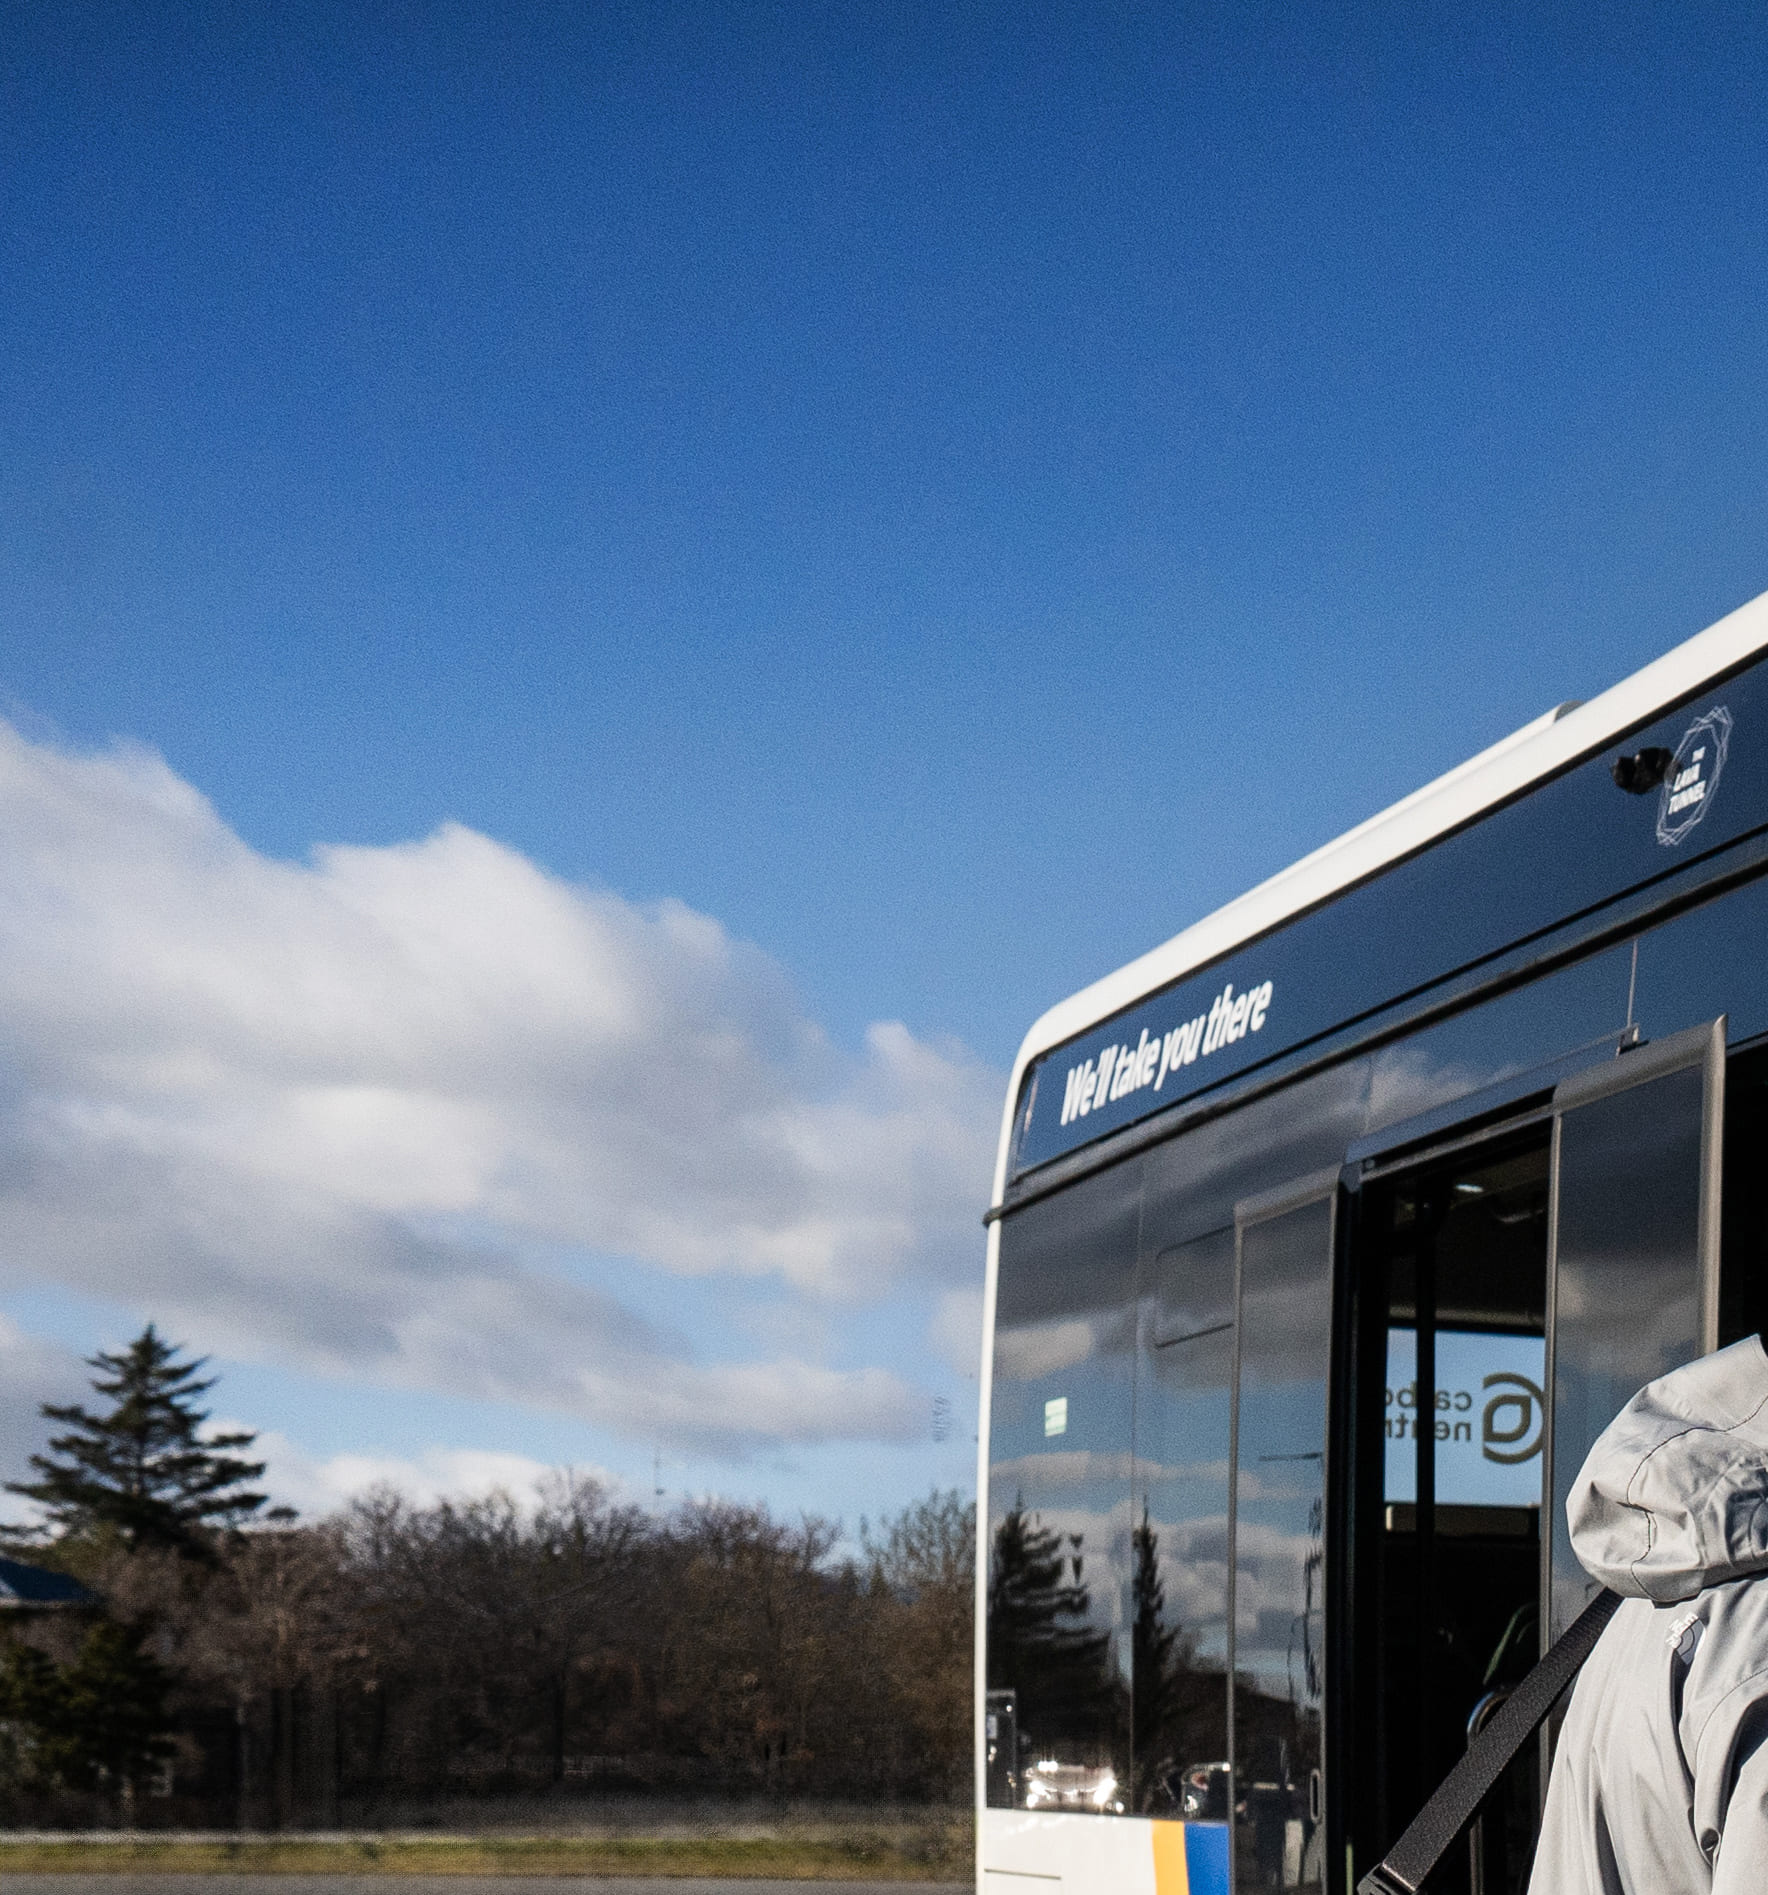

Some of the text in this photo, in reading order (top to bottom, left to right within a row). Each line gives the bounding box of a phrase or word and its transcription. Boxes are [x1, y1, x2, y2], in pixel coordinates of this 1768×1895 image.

[1061, 980, 1273, 1126] We'll take you there
